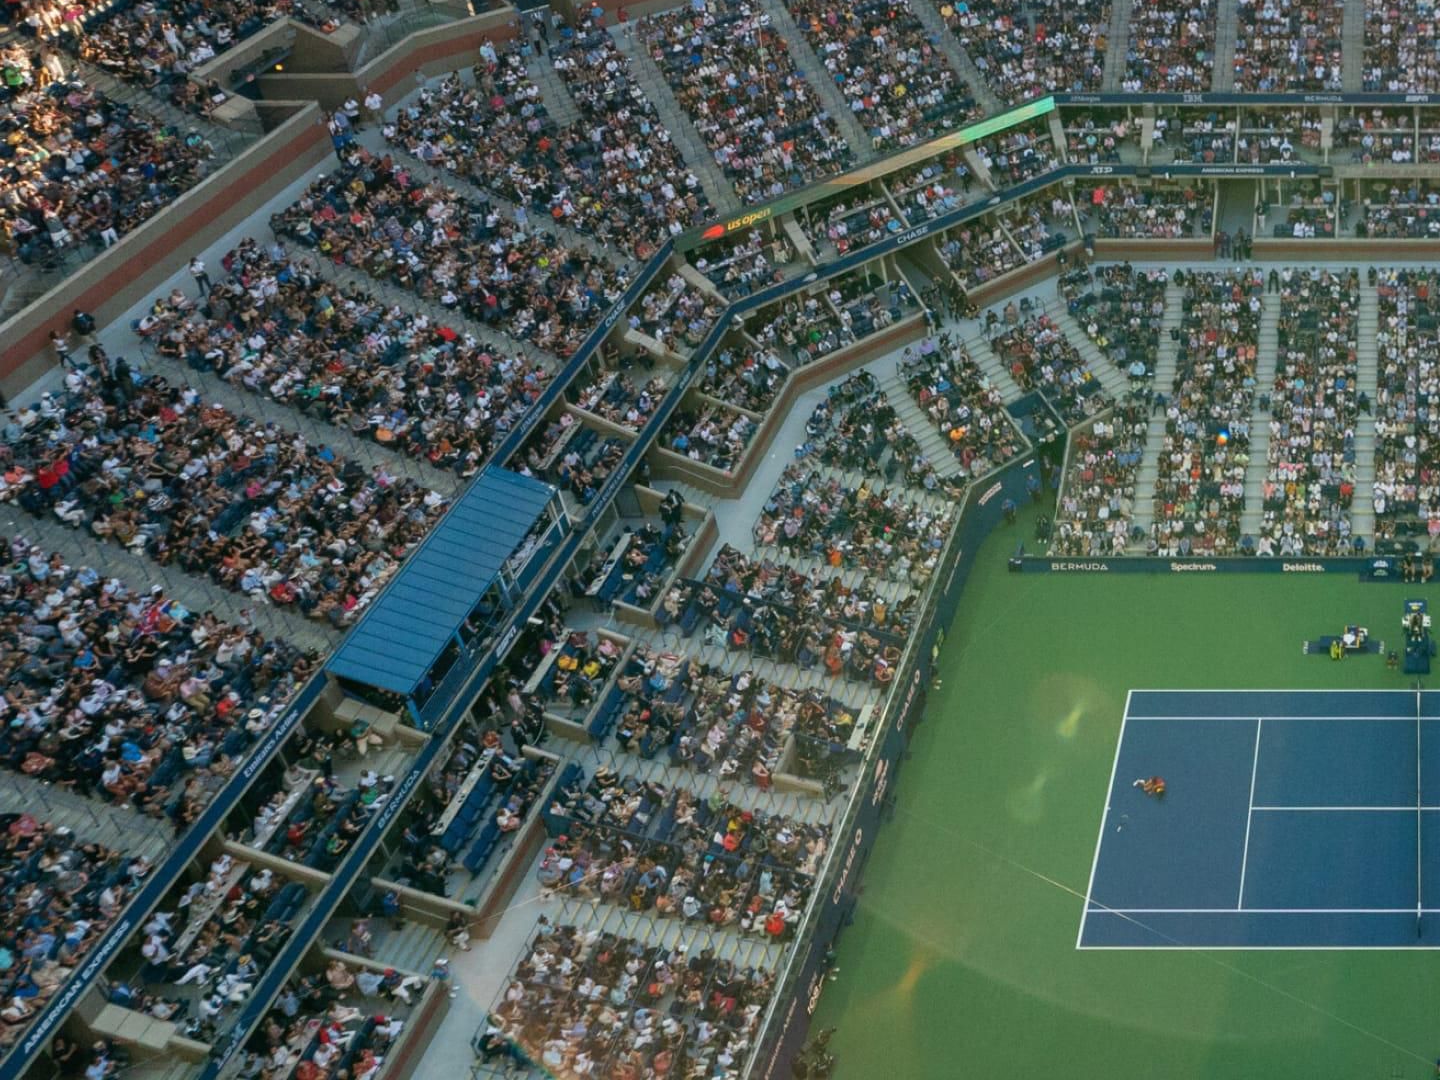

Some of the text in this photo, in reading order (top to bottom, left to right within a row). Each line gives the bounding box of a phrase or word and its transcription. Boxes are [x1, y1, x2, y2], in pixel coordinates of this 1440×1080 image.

[727, 207, 771, 231] us open
[897, 226, 928, 243] CHASE
[605, 300, 626, 327] CHASE
[1171, 562, 1214, 572] Spectrum
[1283, 562, 1325, 572] Deloitte.
[243, 737, 276, 778] Emirates
[377, 769, 421, 829] BERMUDA
[833, 843, 856, 905] CHASE
[24, 920, 130, 1054] AMERICAN EXPRESS
